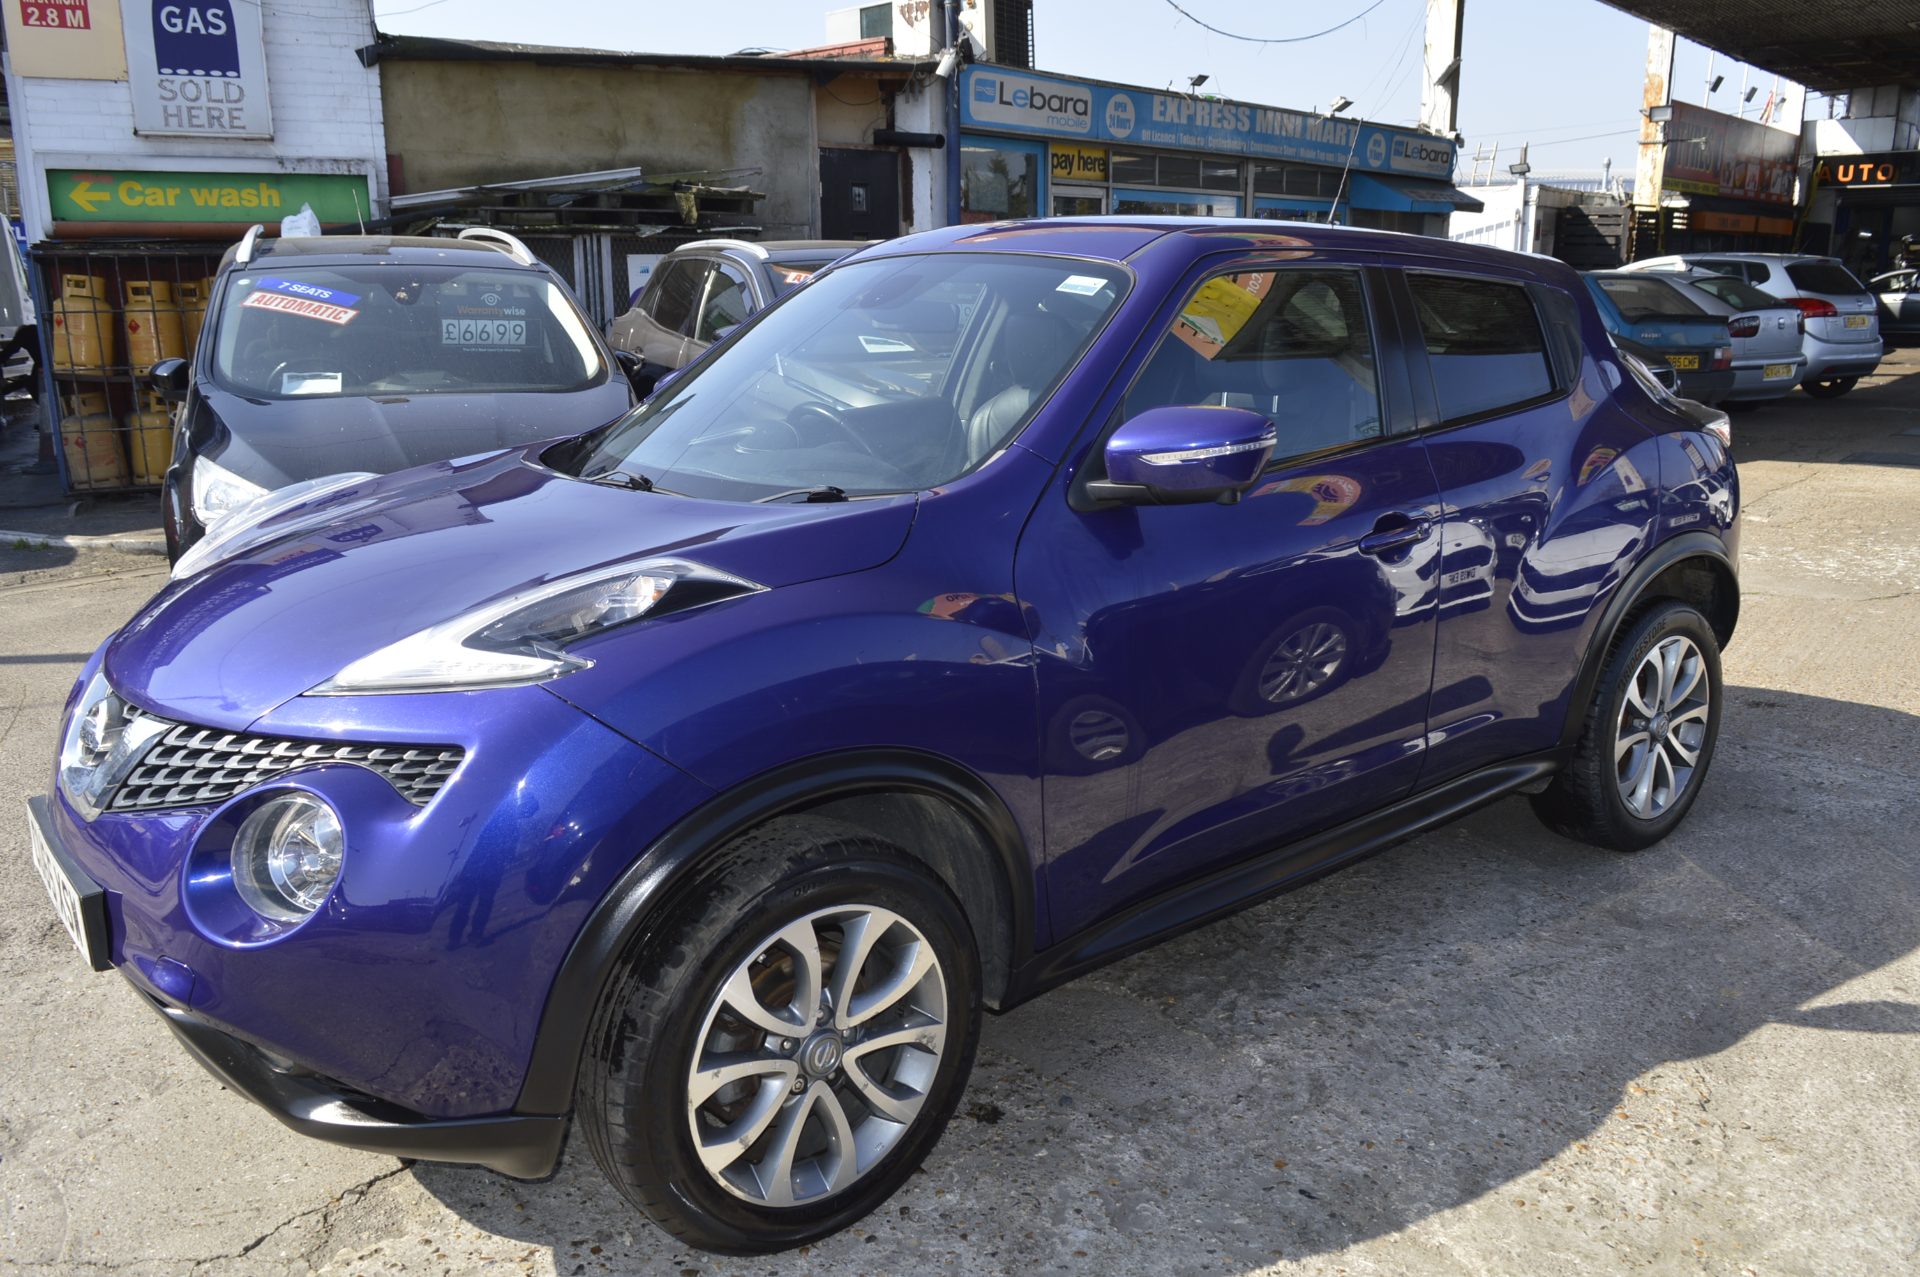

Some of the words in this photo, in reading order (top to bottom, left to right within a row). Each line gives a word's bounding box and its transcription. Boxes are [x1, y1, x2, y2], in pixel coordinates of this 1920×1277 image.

[27, 7, 60, 26] 2.8
[65, 9, 85, 28] M
[160, 6, 228, 35] GAS
[158, 78, 245, 104] SOLD
[999, 81, 1089, 116] Lebara
[162, 104, 247, 130] HERE
[1047, 114, 1088, 129] mobile
[1152, 94, 1251, 132] EXPRESS
[1255, 108, 1303, 139] MINI
[1306, 115, 1360, 148] MART
[1051, 151, 1076, 175] pay
[1077, 149, 1105, 172] here
[1404, 141, 1450, 163] Lebara
[1819, 163, 1894, 182] AUTO
[118, 181, 181, 207] Car
[189, 183, 281, 208] wash
[278, 281, 290, 290] 7
[289, 284, 333, 299] SEATS
[253, 294, 348, 321] AUTOMATIC
[444, 322, 524, 342] £6699
